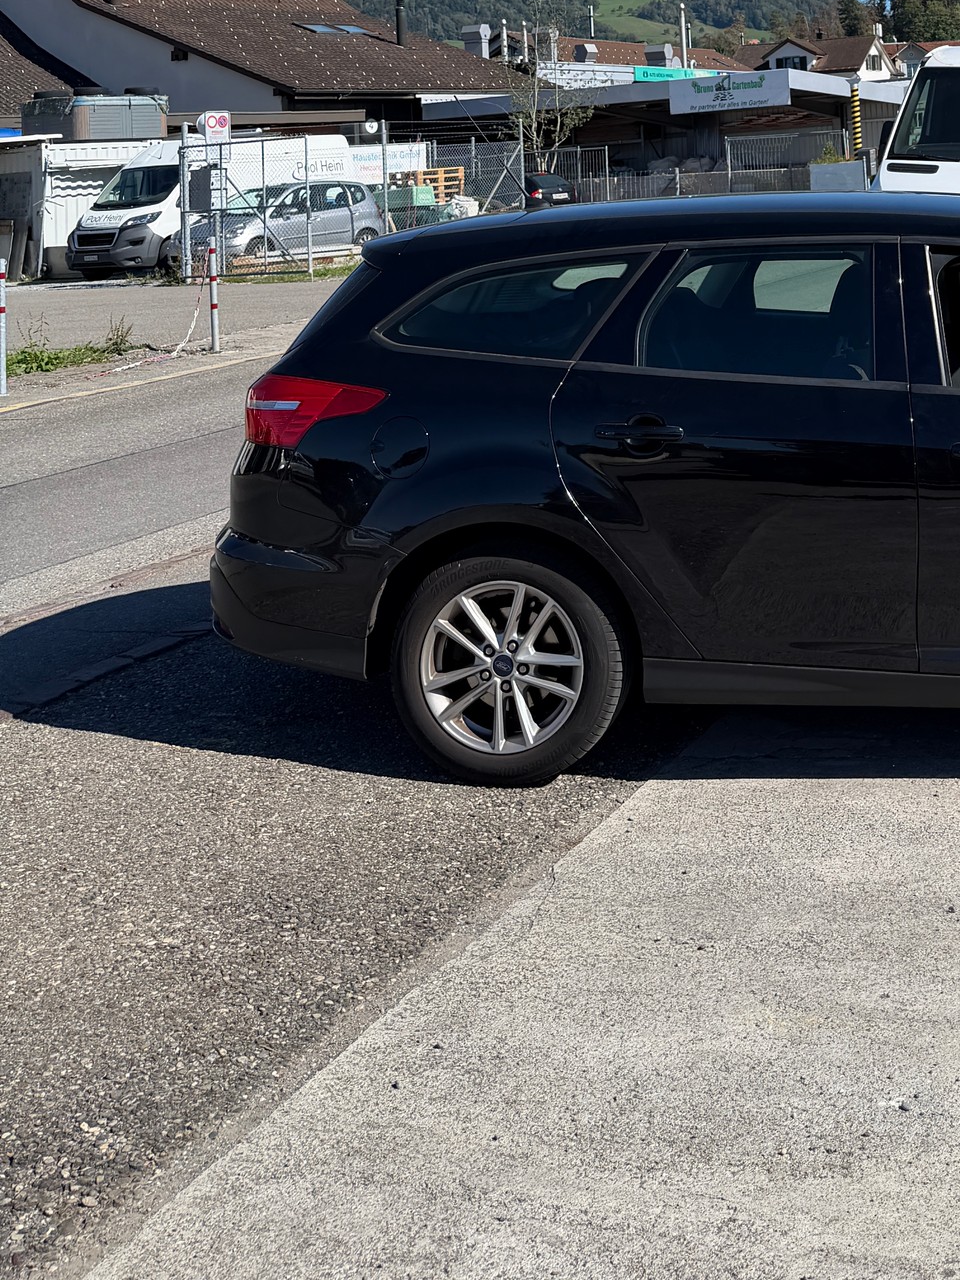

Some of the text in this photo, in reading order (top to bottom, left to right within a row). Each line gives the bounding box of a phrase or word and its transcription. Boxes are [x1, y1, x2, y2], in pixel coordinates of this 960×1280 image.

[696, 80, 763, 94] Bruno Gartenbau
[727, 100, 739, 108] alles
[352, 152, 397, 162] Haustecnik
[320, 159, 344, 172] Heini
[85, 214, 104, 223] Pool
